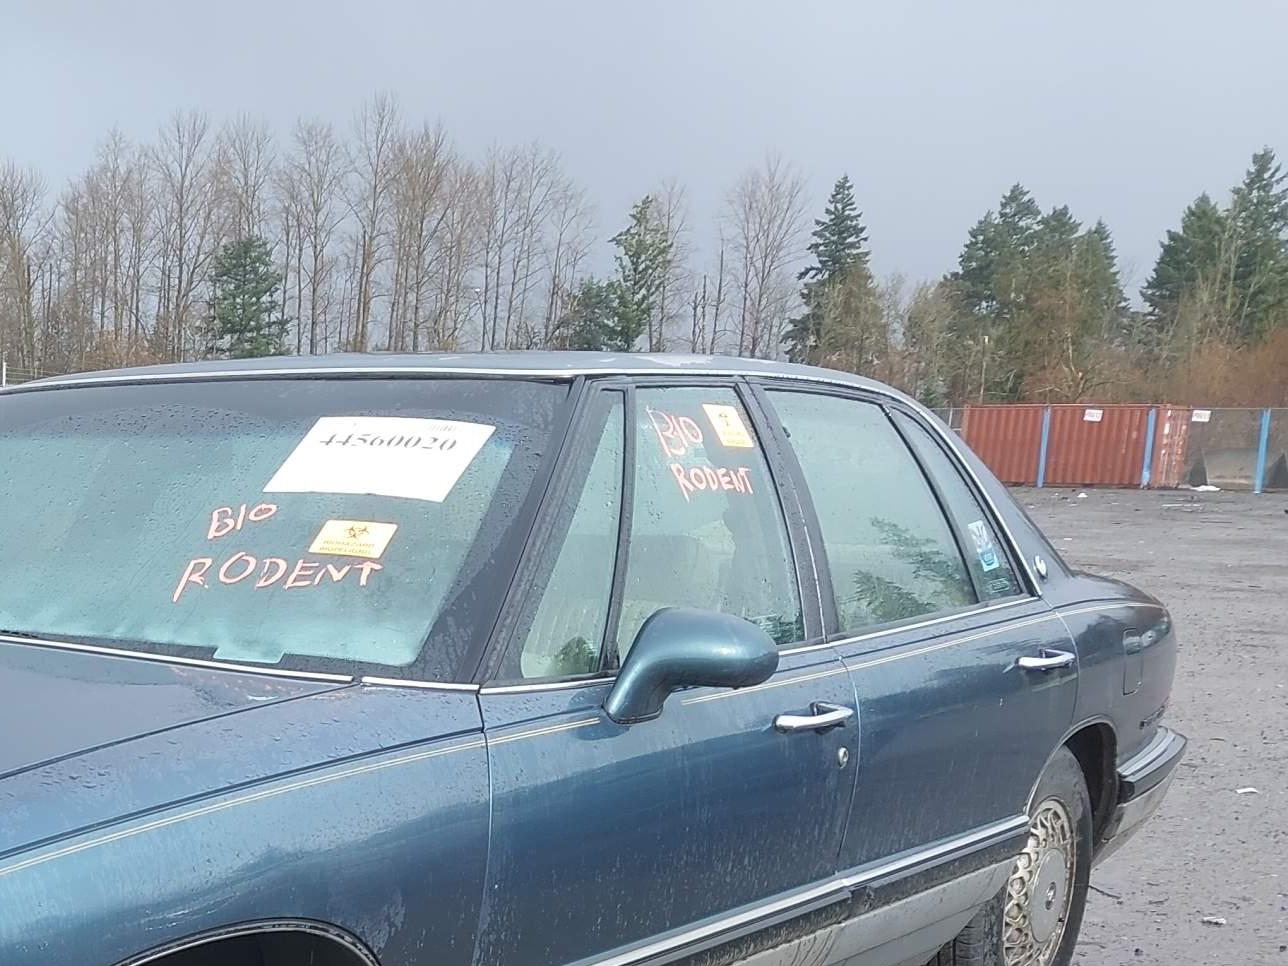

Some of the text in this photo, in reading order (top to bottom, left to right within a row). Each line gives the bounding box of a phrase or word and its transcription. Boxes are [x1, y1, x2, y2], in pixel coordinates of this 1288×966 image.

[319, 433, 458, 451] 44560020
[645, 405, 704, 457] BIO
[669, 463, 754, 503] RODENT
[207, 503, 277, 540] BIO
[172, 551, 384, 603] RODENT
